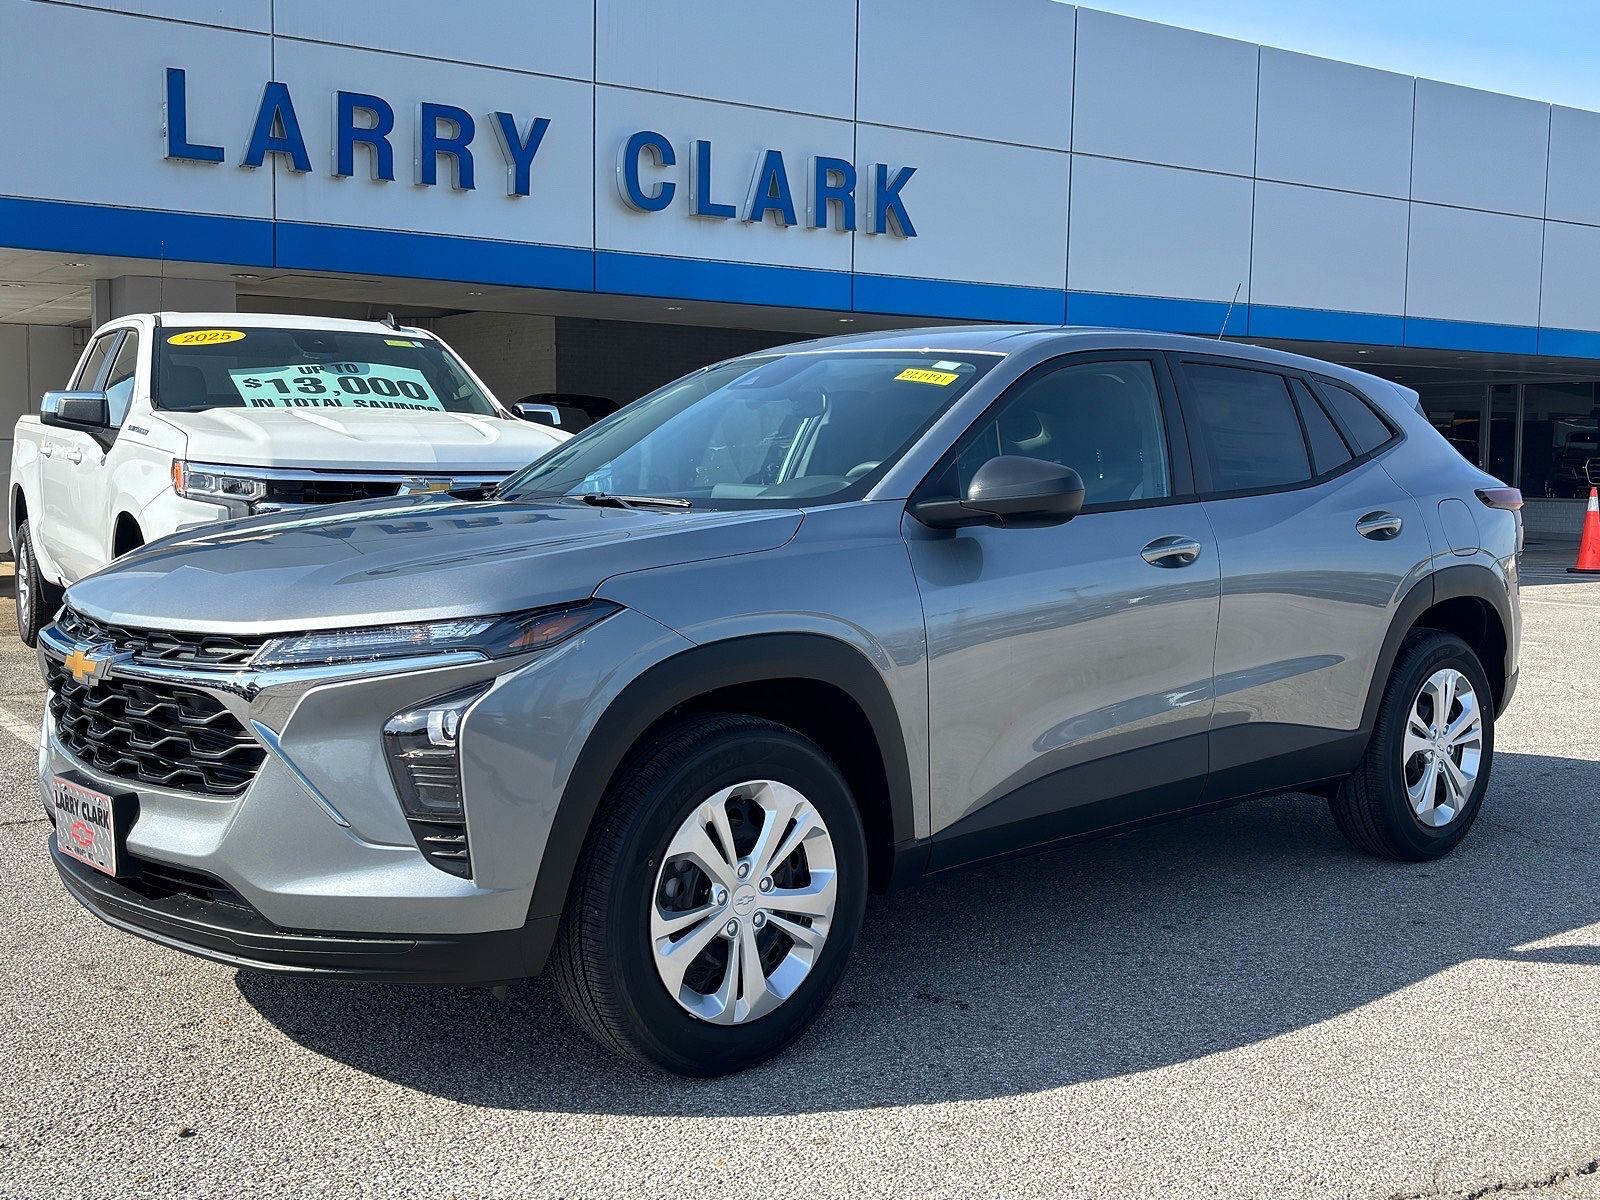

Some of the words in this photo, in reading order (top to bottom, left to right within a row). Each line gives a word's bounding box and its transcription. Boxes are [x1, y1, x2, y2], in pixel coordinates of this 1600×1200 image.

[163, 67, 551, 197] LARRY
[616, 131, 917, 238] CLARK
[182, 332, 232, 343] 2025
[297, 365, 326, 374] UP
[331, 363, 360, 373] TO
[243, 376, 430, 400] $13,000
[250, 398, 276, 408] IN
[55, 790, 79, 817] LARRY
[82, 801, 110, 830] CLARK
